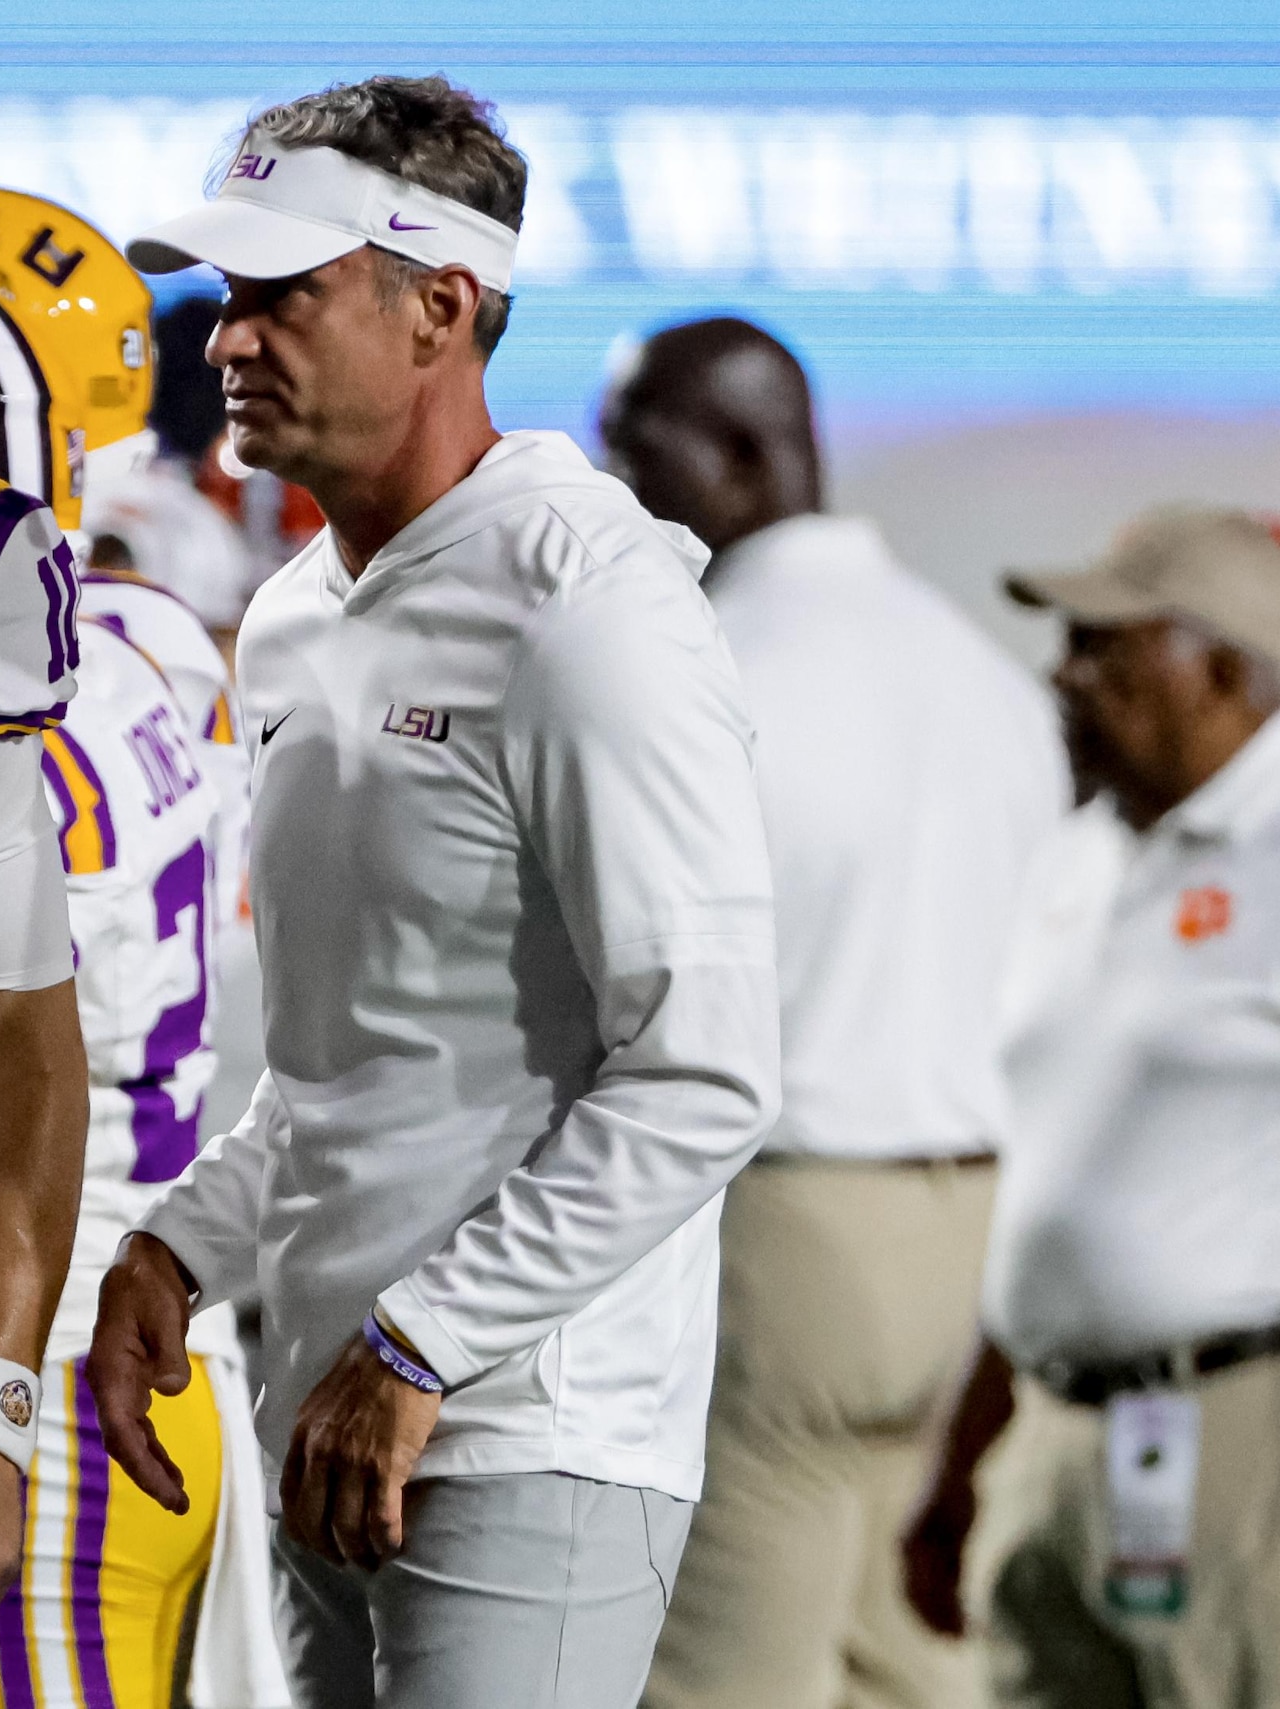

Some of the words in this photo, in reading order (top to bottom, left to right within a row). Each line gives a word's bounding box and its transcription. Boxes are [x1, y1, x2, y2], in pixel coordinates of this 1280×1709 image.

[232, 154, 277, 180] SU
[381, 703, 450, 743] LSU
[393, 1361, 419, 1382] LSU
